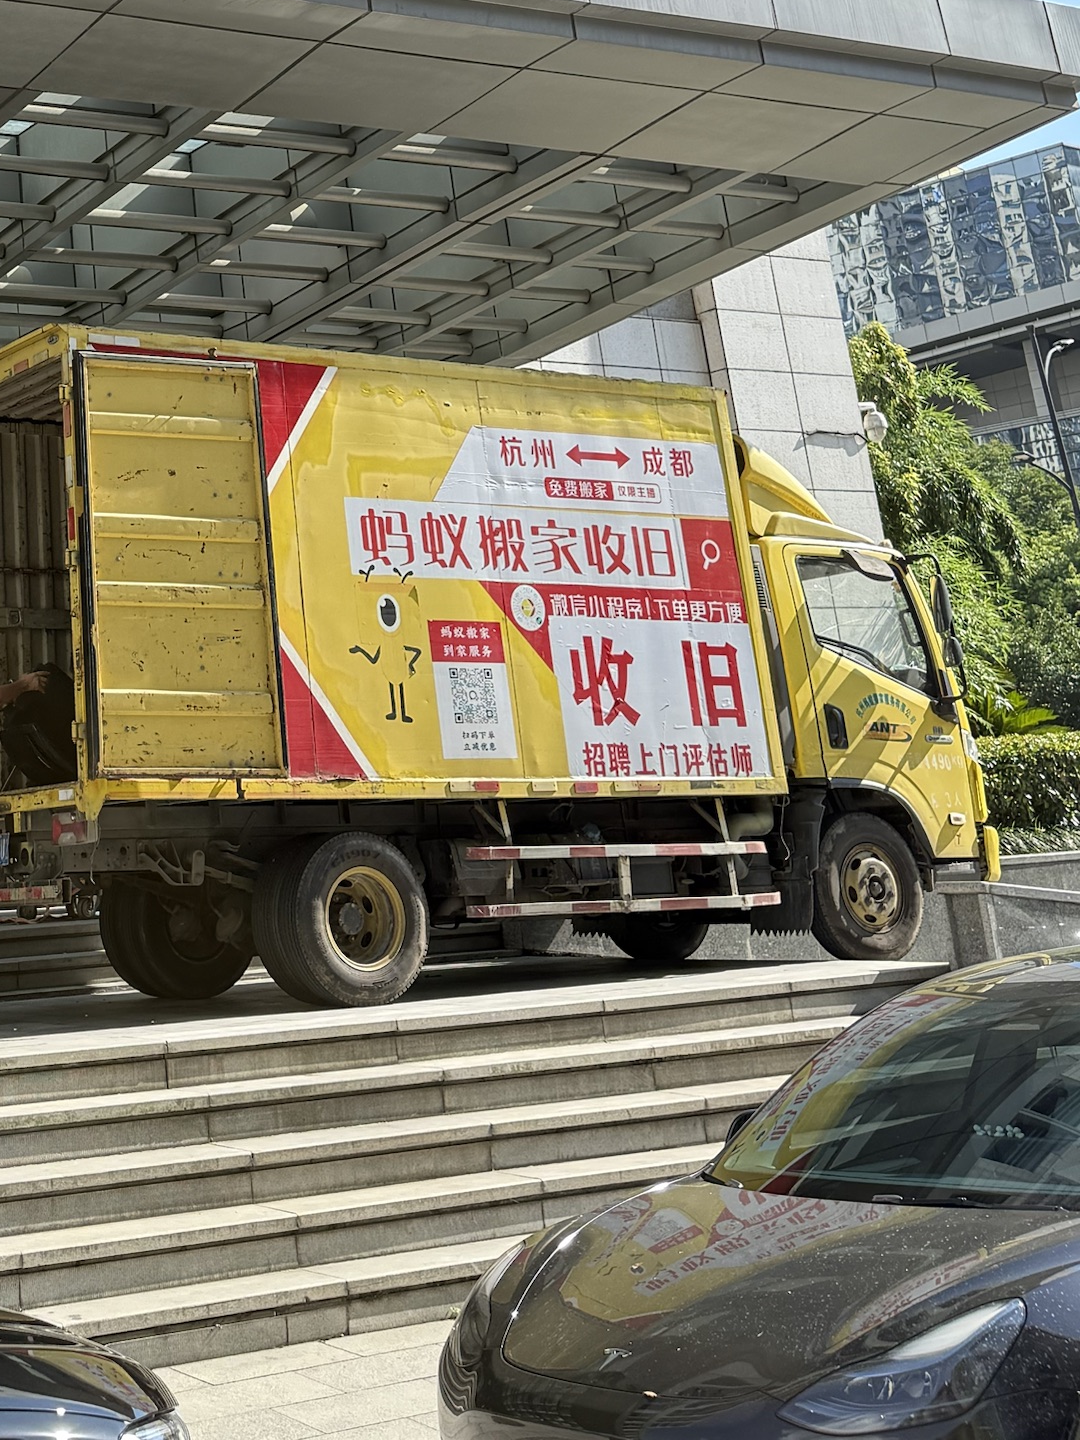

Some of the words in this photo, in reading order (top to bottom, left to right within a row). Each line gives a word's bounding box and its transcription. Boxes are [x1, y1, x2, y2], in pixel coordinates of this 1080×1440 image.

[499, 435, 557, 470] 杭州
[641, 446, 695, 478] 成都
[548, 479, 609, 499] 免费搬家
[617, 485, 656, 499] 仅限主播
[360, 508, 677, 578] 蚂蚁搬家收旧
[440, 625, 491, 640] 蚂蚁搬家
[443, 644, 493, 658] 到家服务
[462, 730, 496, 740] 扫码下单
[869, 721, 899, 734] ANT
[463, 742, 497, 752] 立减优惠
[582, 741, 754, 777] 招聘上门评估师
